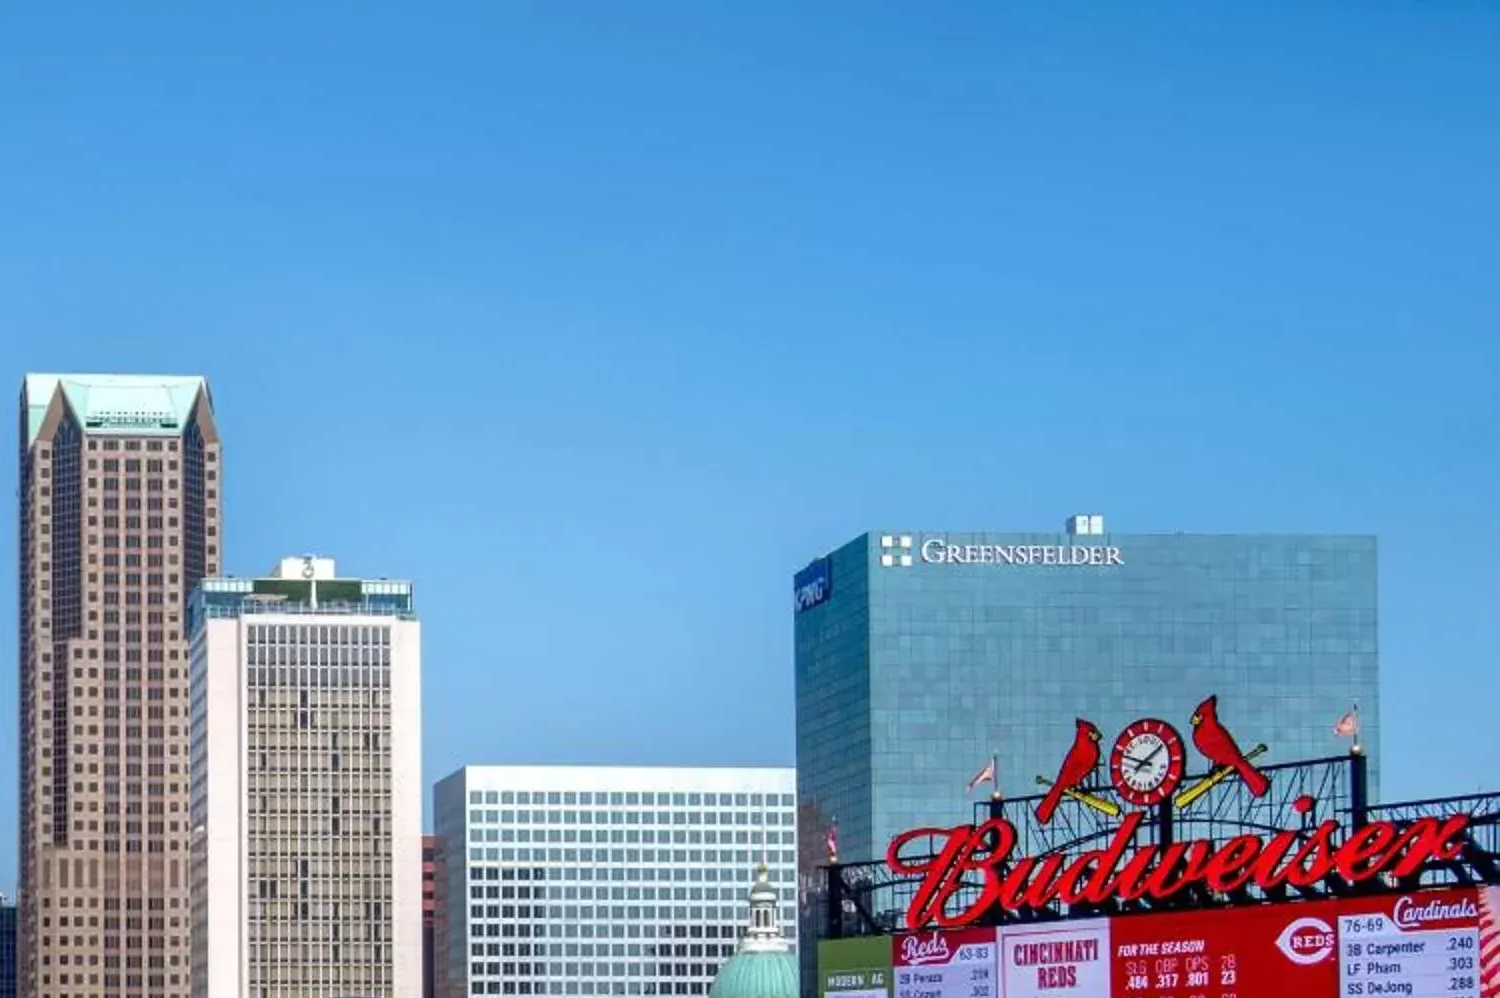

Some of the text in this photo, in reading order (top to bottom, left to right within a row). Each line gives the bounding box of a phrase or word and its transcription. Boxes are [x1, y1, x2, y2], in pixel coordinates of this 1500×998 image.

[921, 538, 1125, 566] GREENSFELDER
[886, 796, 1472, 930] Budweiser
[1393, 896, 1478, 927] Cardinals
[1344, 918, 1383, 933] 76-69
[901, 931, 950, 964] Reds
[1118, 940, 1204, 957] FOR THE SEASON
[1293, 933, 1334, 949] REDS
[1367, 936, 1473, 956] Carpenter .240
[1013, 939, 1098, 966] CINCINNATI
[1347, 956, 1473, 976] LF Pham .303
[1037, 965, 1076, 989] REDS
[1155, 970, 1236, 988] .317 .801 23
[1348, 982, 1362, 995] SS
[1368, 981, 1413, 996] DeJong
